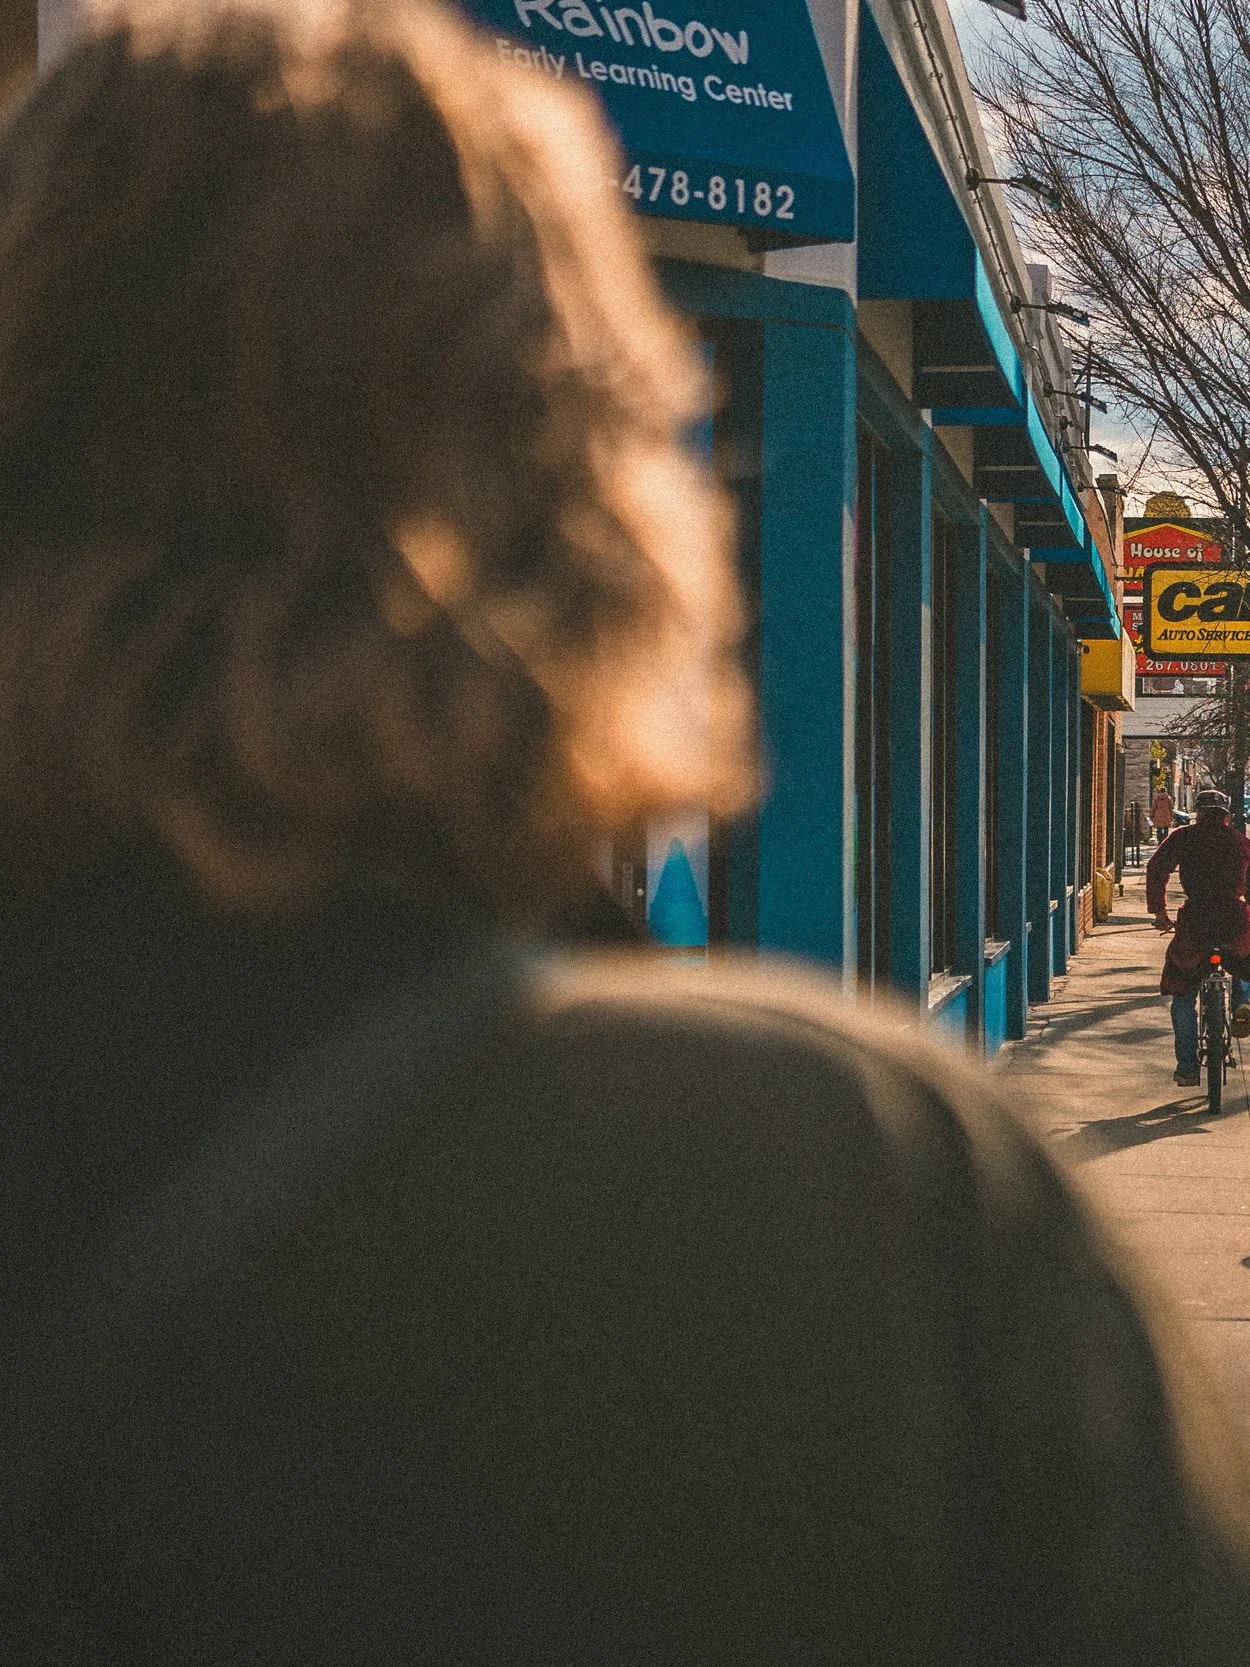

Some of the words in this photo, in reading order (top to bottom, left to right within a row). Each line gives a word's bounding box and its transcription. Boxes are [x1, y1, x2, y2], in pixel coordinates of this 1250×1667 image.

[514, 0, 749, 65] Rainbow
[575, 51, 698, 101] Learning
[703, 74, 794, 111] Center
[1130, 542, 1181, 558] House
[1157, 628, 1196, 641] AUTO
